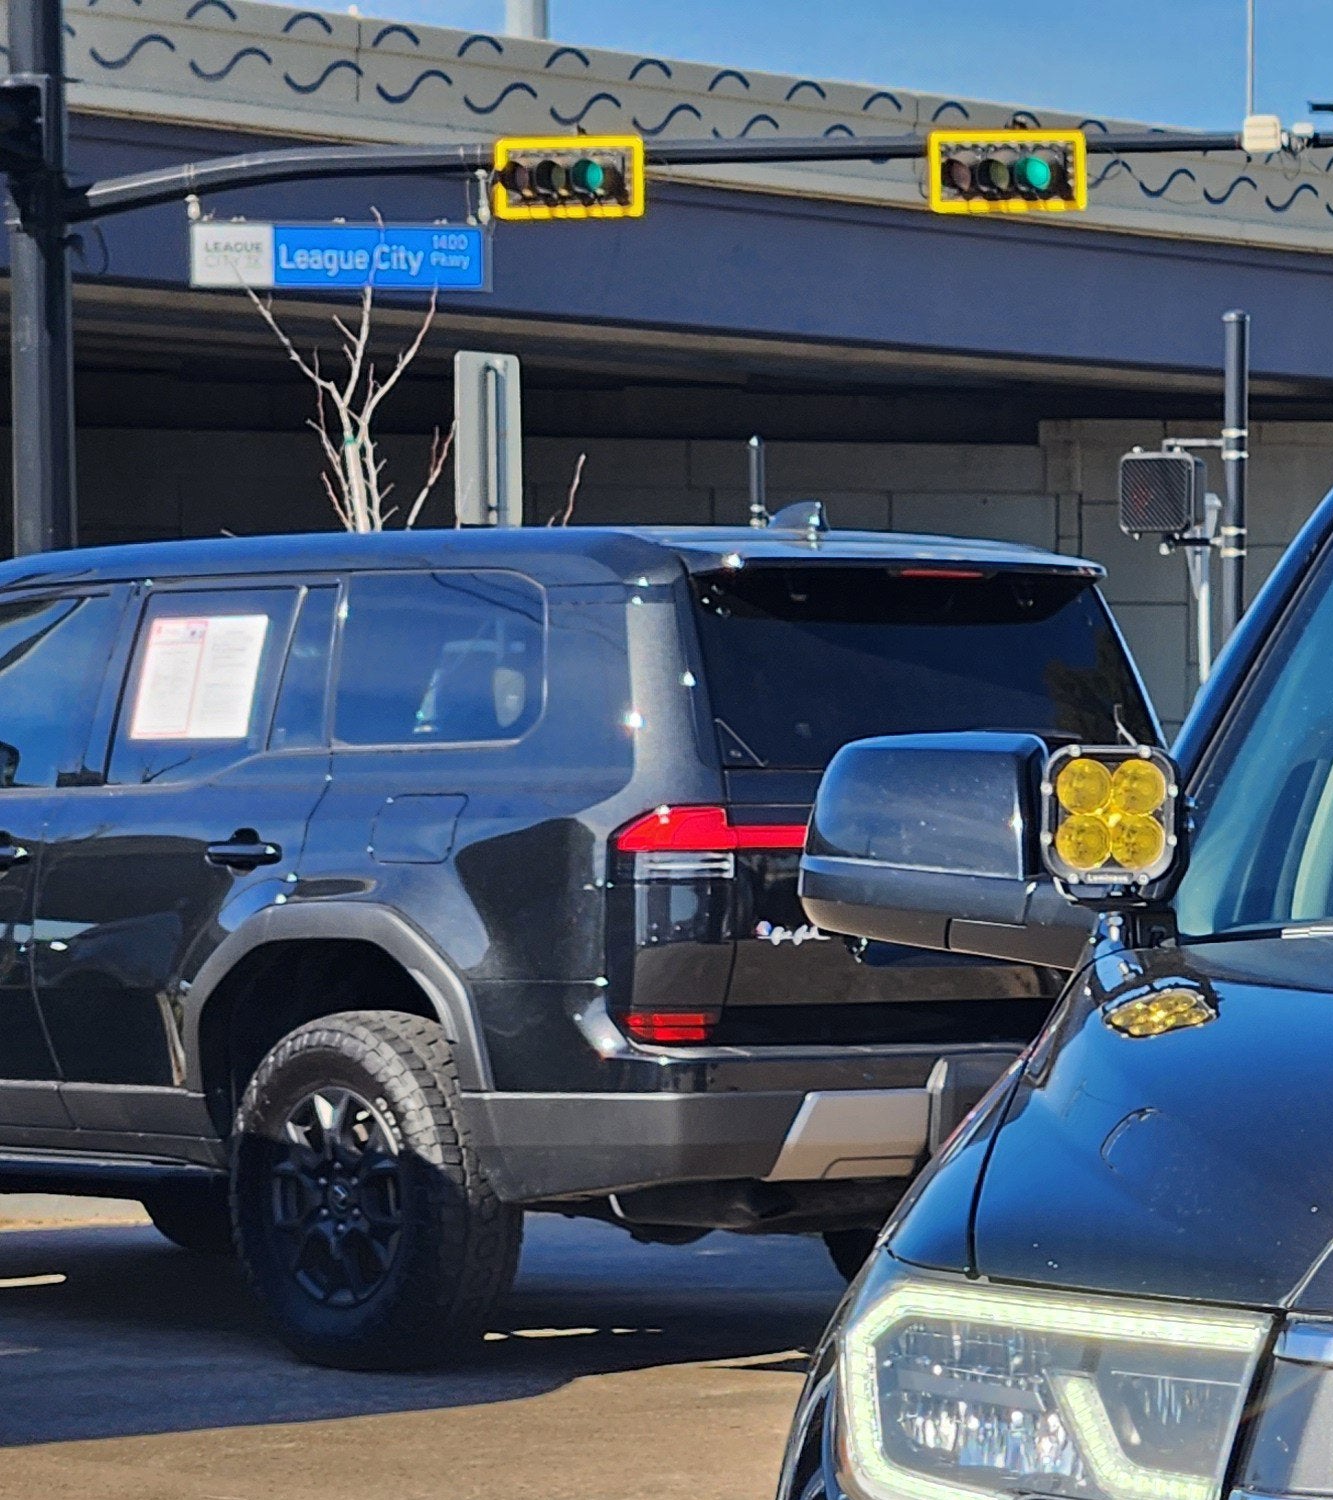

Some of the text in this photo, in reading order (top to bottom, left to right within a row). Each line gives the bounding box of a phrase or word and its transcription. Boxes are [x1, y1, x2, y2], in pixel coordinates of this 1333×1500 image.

[205, 241, 262, 253] LEAGUE
[279, 244, 424, 277] League City
